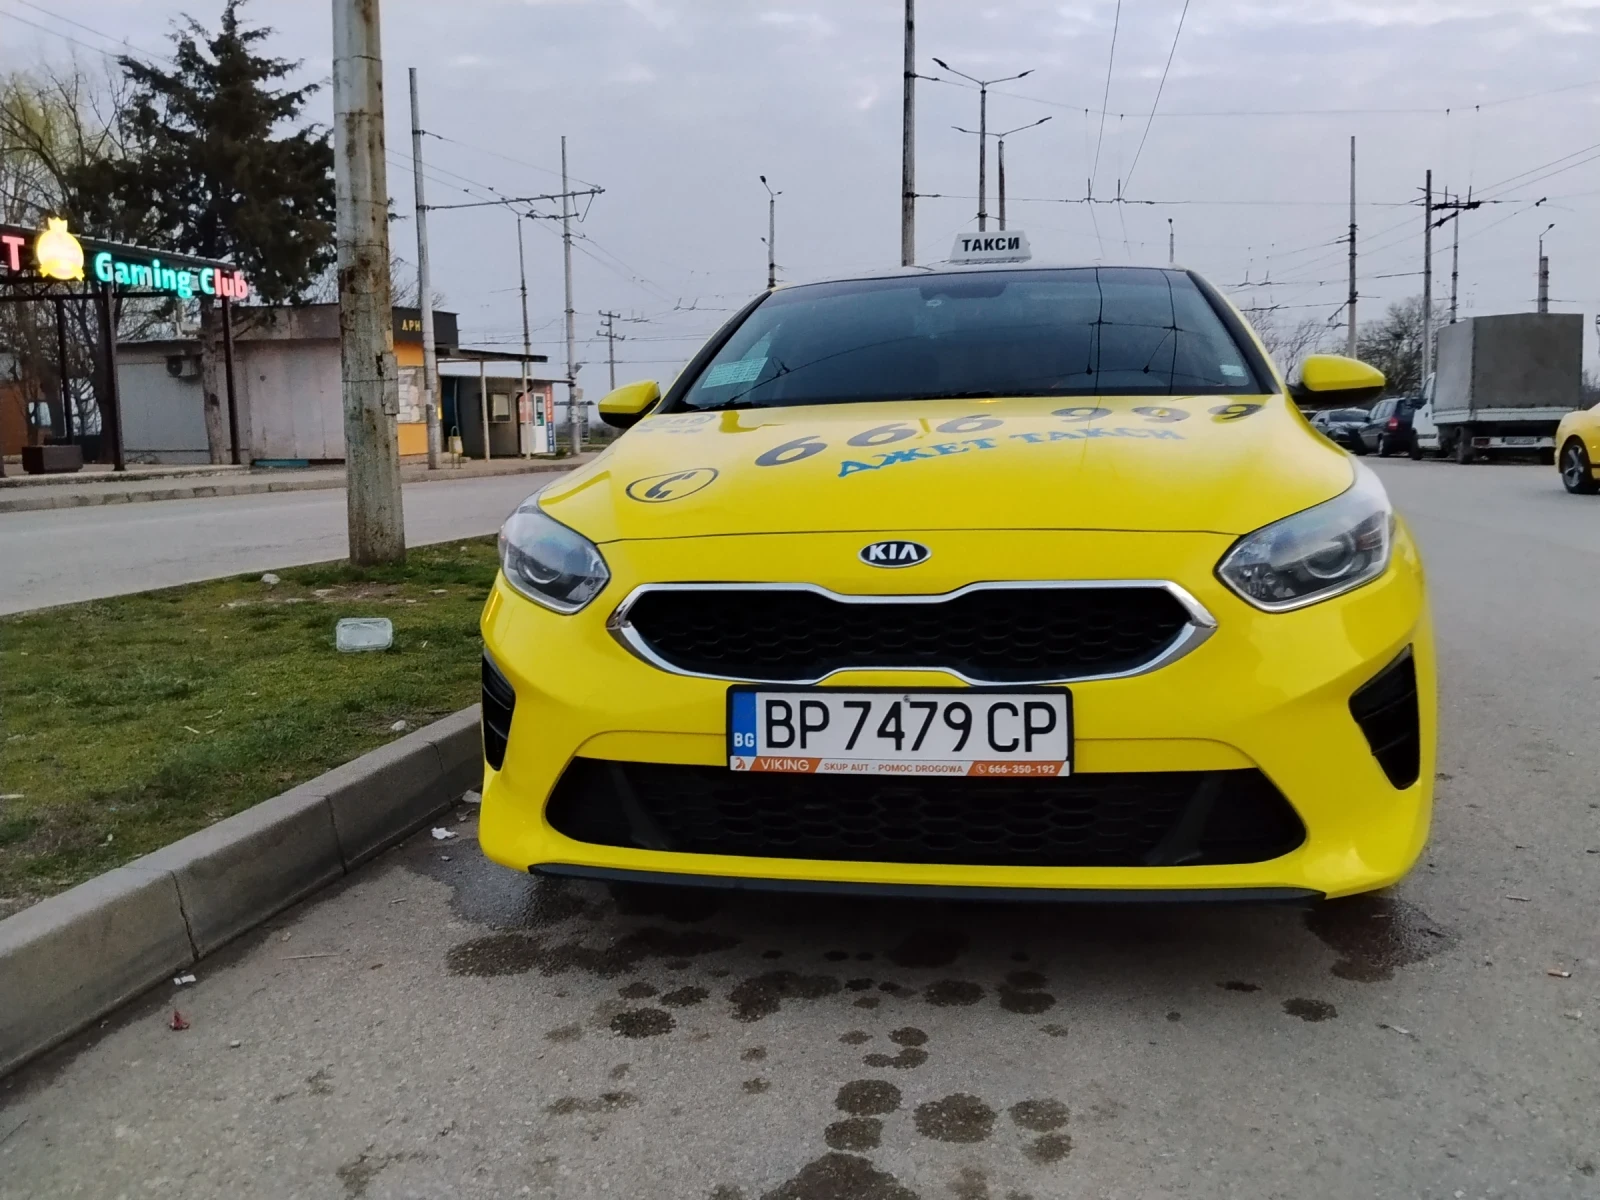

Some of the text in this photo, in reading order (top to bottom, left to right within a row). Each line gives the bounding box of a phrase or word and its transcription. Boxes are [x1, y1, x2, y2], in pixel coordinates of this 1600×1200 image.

[961, 237, 1020, 252] ТАКСИ
[95, 251, 249, 299] Gaming Club
[837, 426, 1188, 479] ДЖЕТ ТАКСИ
[868, 543, 919, 561] KIA
[765, 699, 1058, 753] BP 7479 CP
[733, 732, 755, 748] BG
[760, 758, 810, 773] VIKING
[823, 762, 849, 773] SKUP
[850, 763, 869, 773] AUT
[878, 763, 914, 774] POMOC
[915, 764, 964, 774] DROGOWA
[987, 764, 1056, 775] 666-350-192
